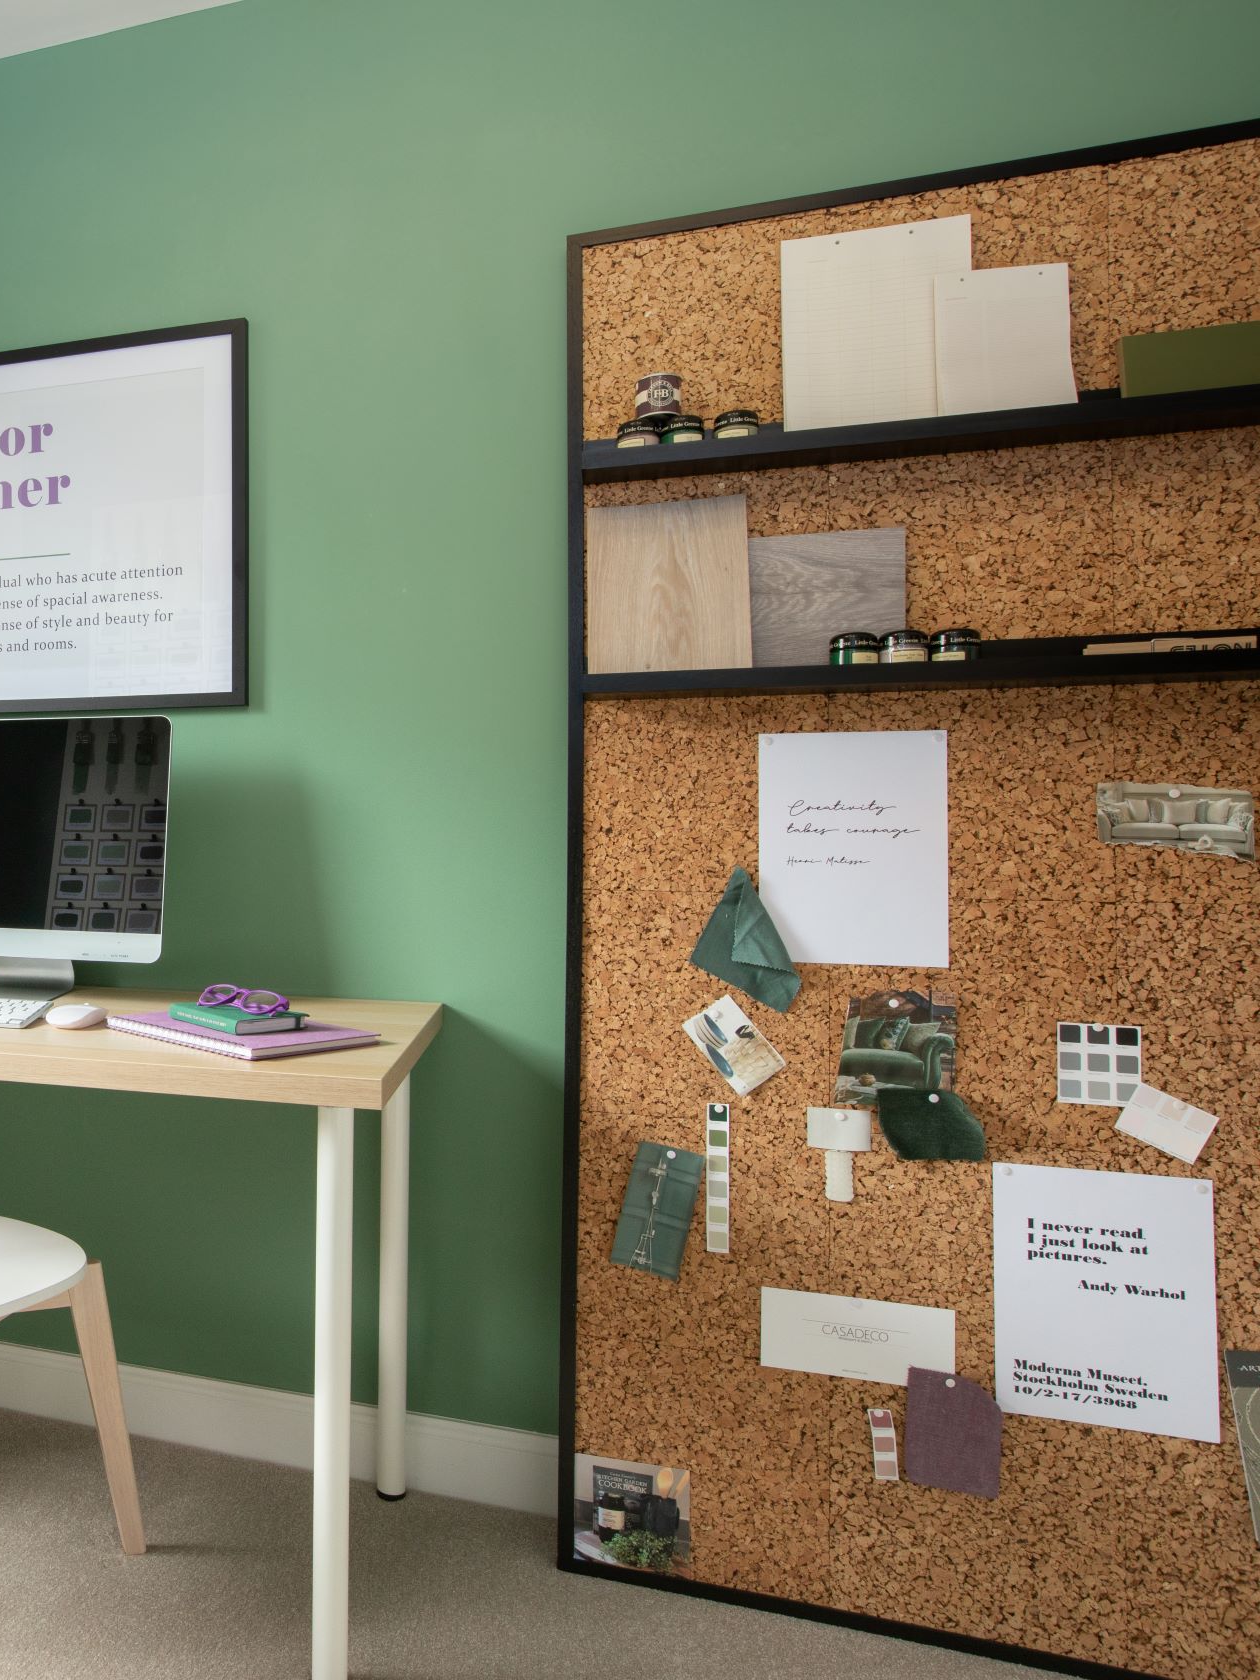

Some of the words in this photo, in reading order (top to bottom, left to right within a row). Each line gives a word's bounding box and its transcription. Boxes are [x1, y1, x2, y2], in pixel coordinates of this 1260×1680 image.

[25, 572, 52, 587] who
[56, 571, 78, 585] has
[81, 570, 117, 583] acute
[120, 564, 184, 580] attention
[26, 594, 41, 608] of
[43, 591, 88, 610] spacial
[91, 589, 163, 605] awareness.
[25, 616, 40, 631] of
[42, 614, 73, 632] style
[76, 612, 100, 628] and
[105, 611, 150, 627] beauty
[154, 608, 175, 624] for
[6, 638, 29, 653] and
[34, 638, 78, 652] rooms.
[787, 800, 897, 817] Creativity
[786, 823, 839, 835] takes
[846, 827, 922, 839] courage
[825, 856, 872, 867] Matisse
[1027, 1217, 1035, 1229] I
[1042, 1222, 1094, 1235] never
[1027, 1232, 1035, 1244] I
[1041, 1234, 1076, 1248] just
[1082, 1238, 1124, 1253] look
[1130, 1245, 1150, 1256] at
[1027, 1247, 1108, 1265] pictures.
[1077, 1279, 1119, 1296] Andy
[1124, 1284, 1187, 1301] Warhol
[821, 1324, 889, 1343] CASADECO
[1013, 1358, 1082, 1378] Moderna
[1087, 1368, 1149, 1387] Museet.
[1012, 1370, 1099, 1392] Stockholm
[1104, 1383, 1169, 1402] Sweden
[598, 1479, 648, 1494] COOKBOOK
